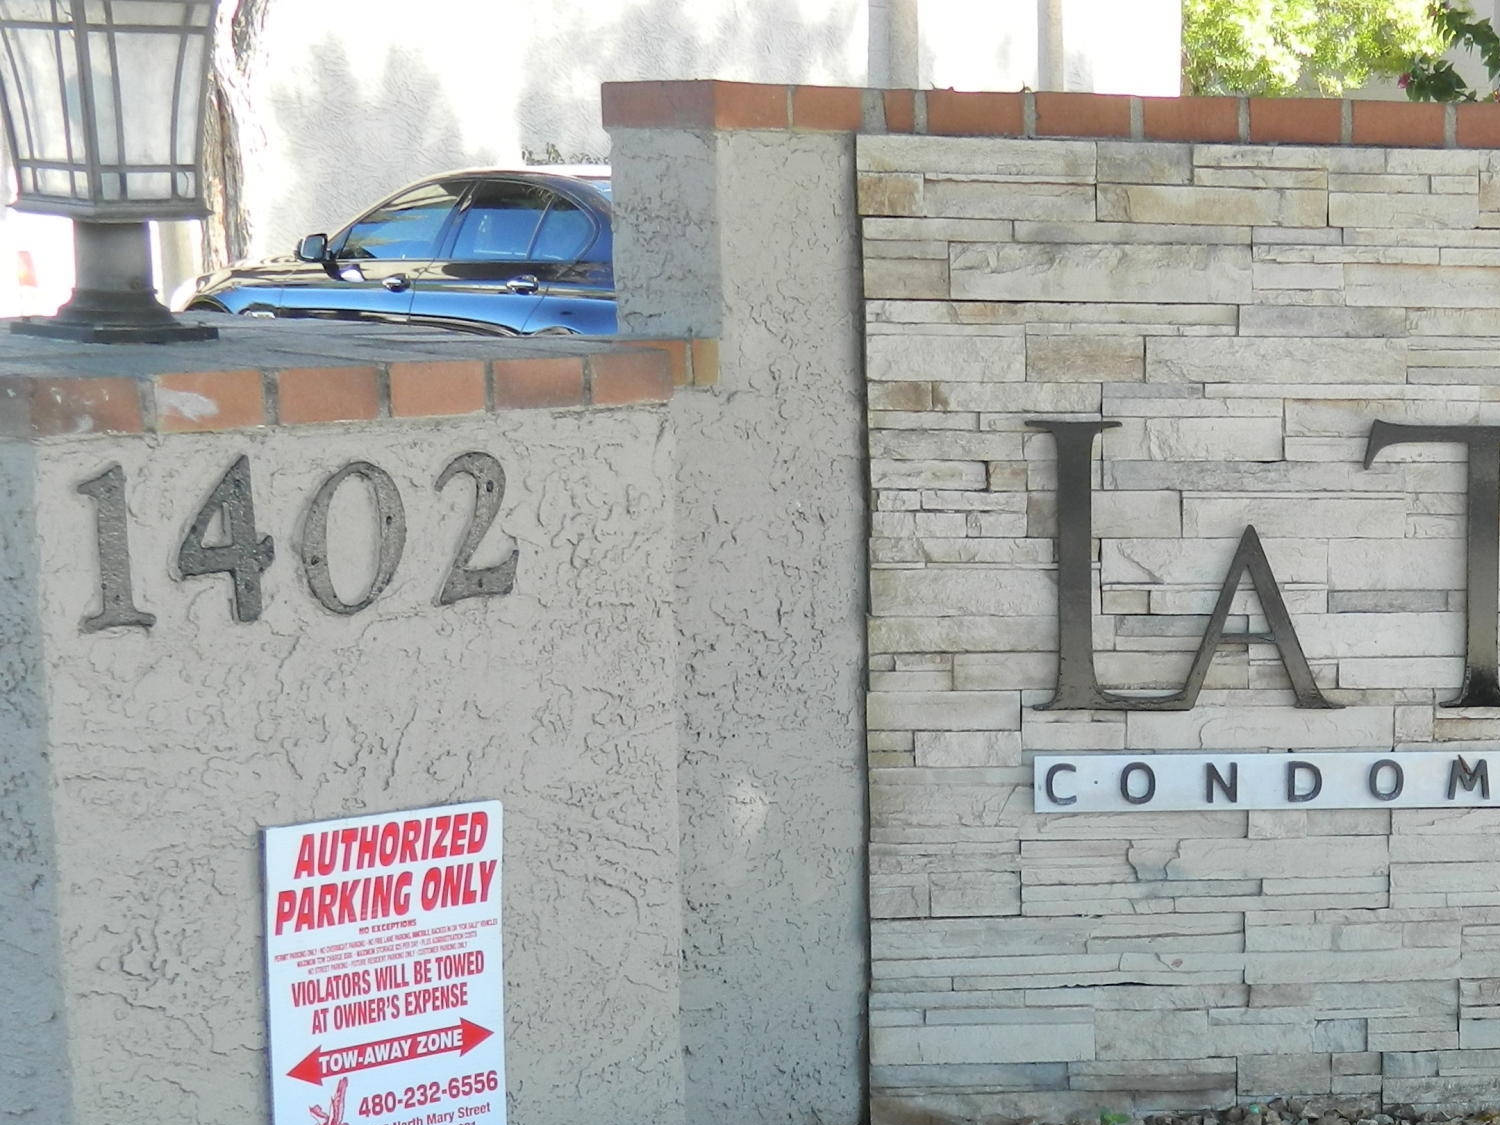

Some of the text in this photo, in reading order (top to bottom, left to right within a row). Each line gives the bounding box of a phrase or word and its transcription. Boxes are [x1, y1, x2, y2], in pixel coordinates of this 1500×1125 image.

[77, 452, 518, 633] 1402
[1025, 420, 1345, 711] LA
[294, 811, 488, 879] AUTHORIZED
[275, 860, 497, 935] PARKING ONLY
[359, 919, 417, 935] NO EXCEPTIONS
[291, 971, 371, 1008] VIOLATORS
[375, 963, 409, 992] WILL
[414, 960, 432, 985] BE
[435, 950, 485, 981] TOWED
[312, 982, 468, 1034] AT OWNER'S EXPENSE
[319, 1029, 463, 1074] TOW-AWAY ZONE
[358, 1070, 498, 1117] 480-232-6556
[427, 1111, 454, 1125] Mary
[458, 1102, 490, 1119] Street
